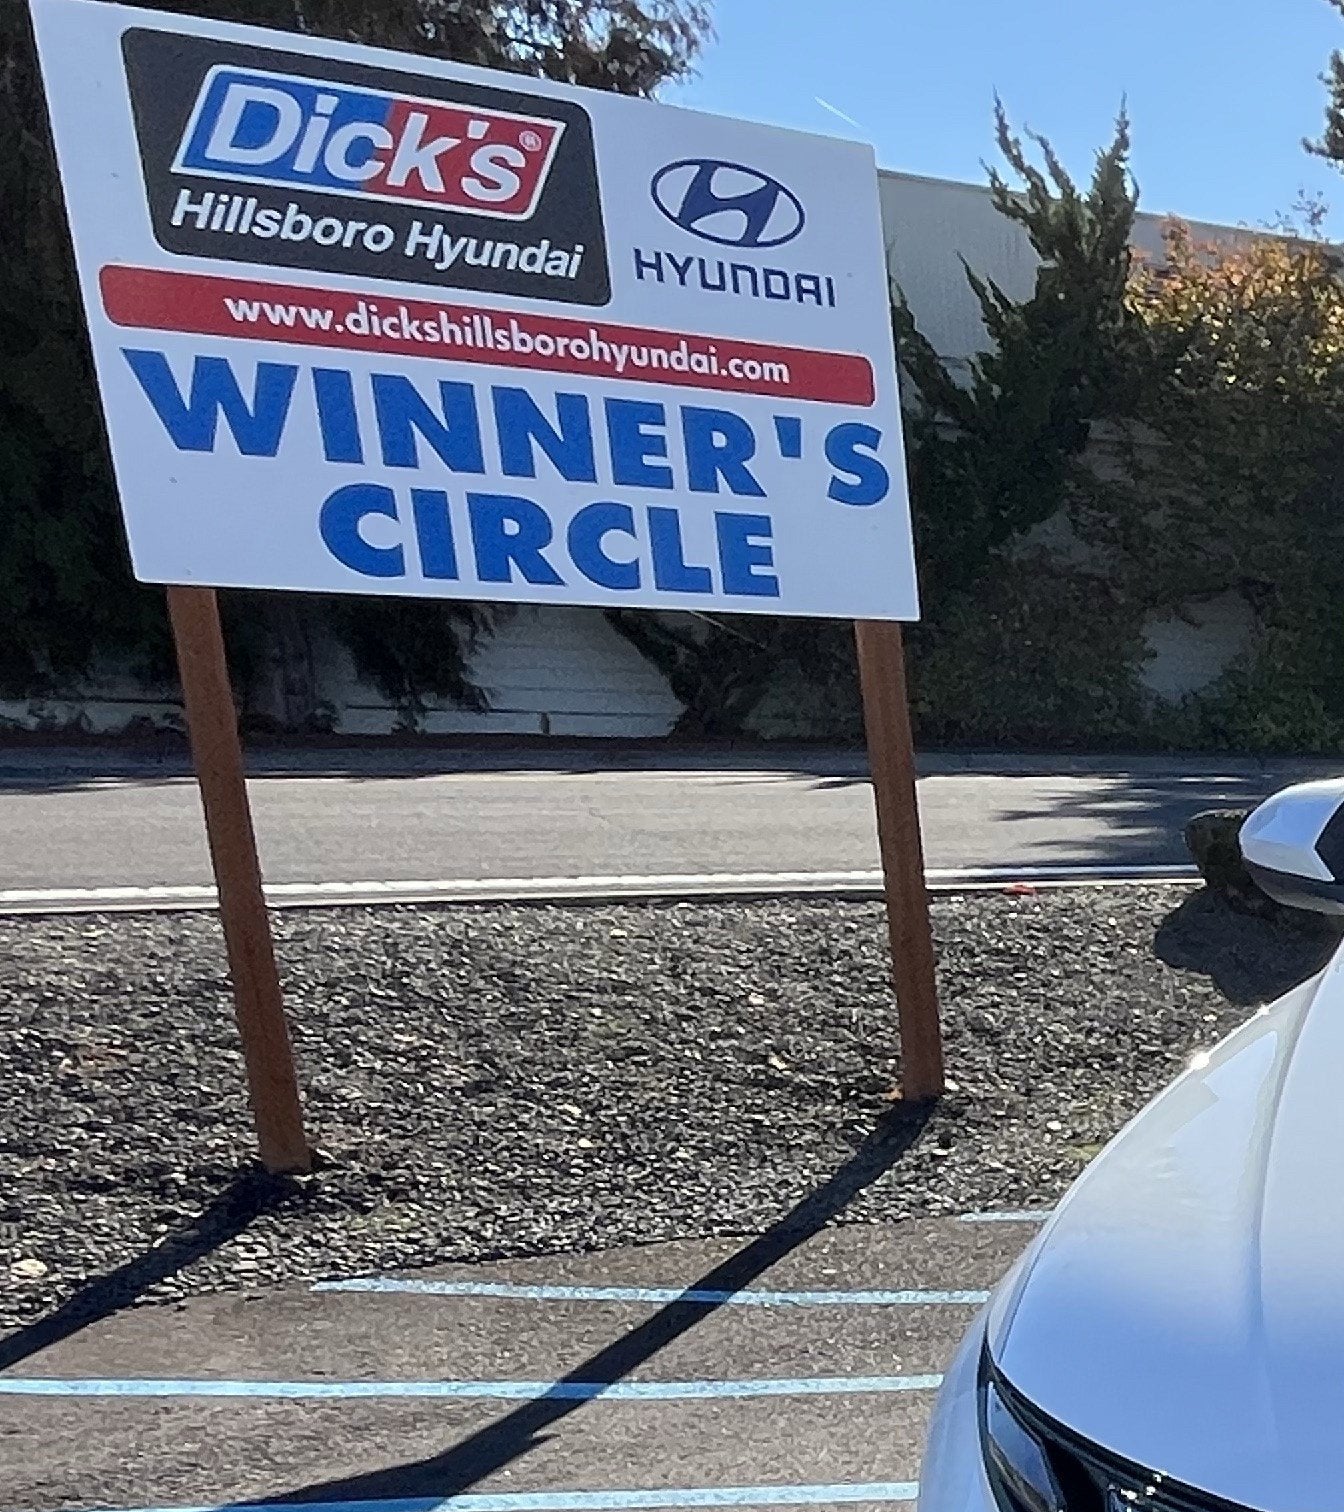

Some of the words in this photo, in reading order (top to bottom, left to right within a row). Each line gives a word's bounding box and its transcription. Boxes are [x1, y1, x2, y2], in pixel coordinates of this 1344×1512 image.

[205, 82, 525, 202] Dick's
[170, 190, 394, 252] Hillsboro
[404, 219, 584, 280] Hyundai
[634, 248, 836, 307] HYUNDAI
[224, 294, 791, 384] www.dickshillsborohyundai.com
[121, 348, 889, 506] WINNER'S
[319, 483, 780, 597] CIRCLE
